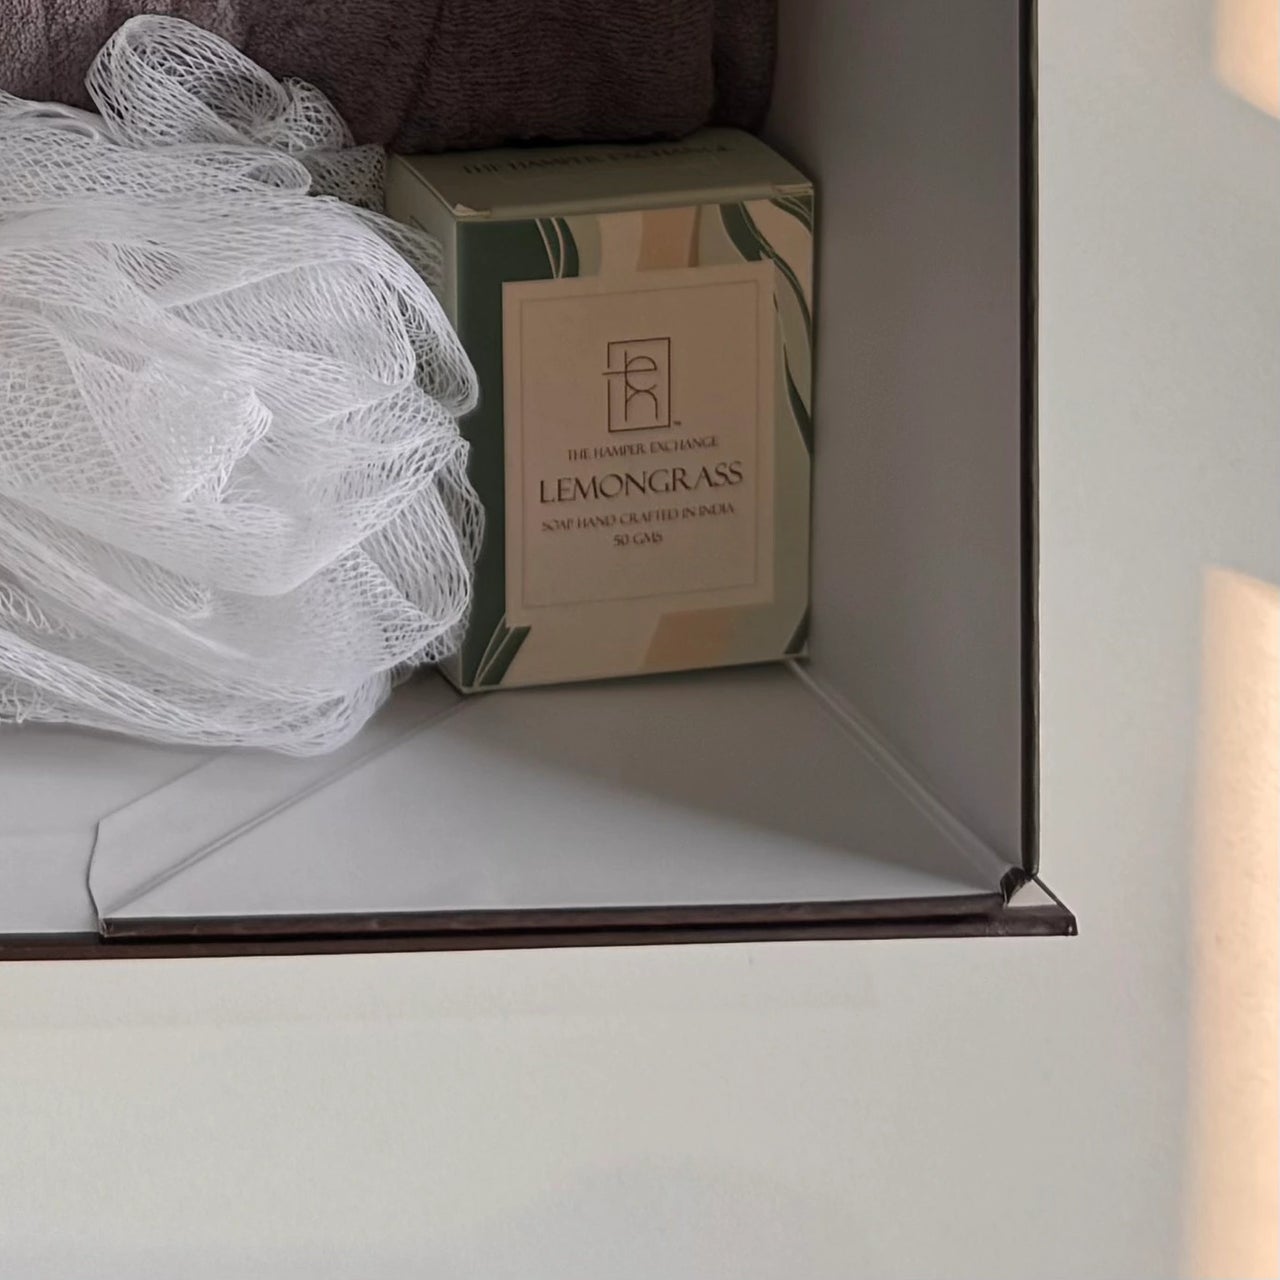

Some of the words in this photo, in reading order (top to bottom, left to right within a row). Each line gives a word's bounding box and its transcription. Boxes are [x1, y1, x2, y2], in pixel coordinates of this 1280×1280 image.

[567, 448, 590, 461] THE
[593, 442, 645, 459] HAMPER
[649, 435, 719, 455] EXCHANGE
[539, 461, 743, 505] LEMONGRASS
[577, 515, 617, 530] HAND
[619, 508, 679, 526] CRAFTED
[682, 507, 696, 519] IN
[697, 502, 736, 518] INDIA
